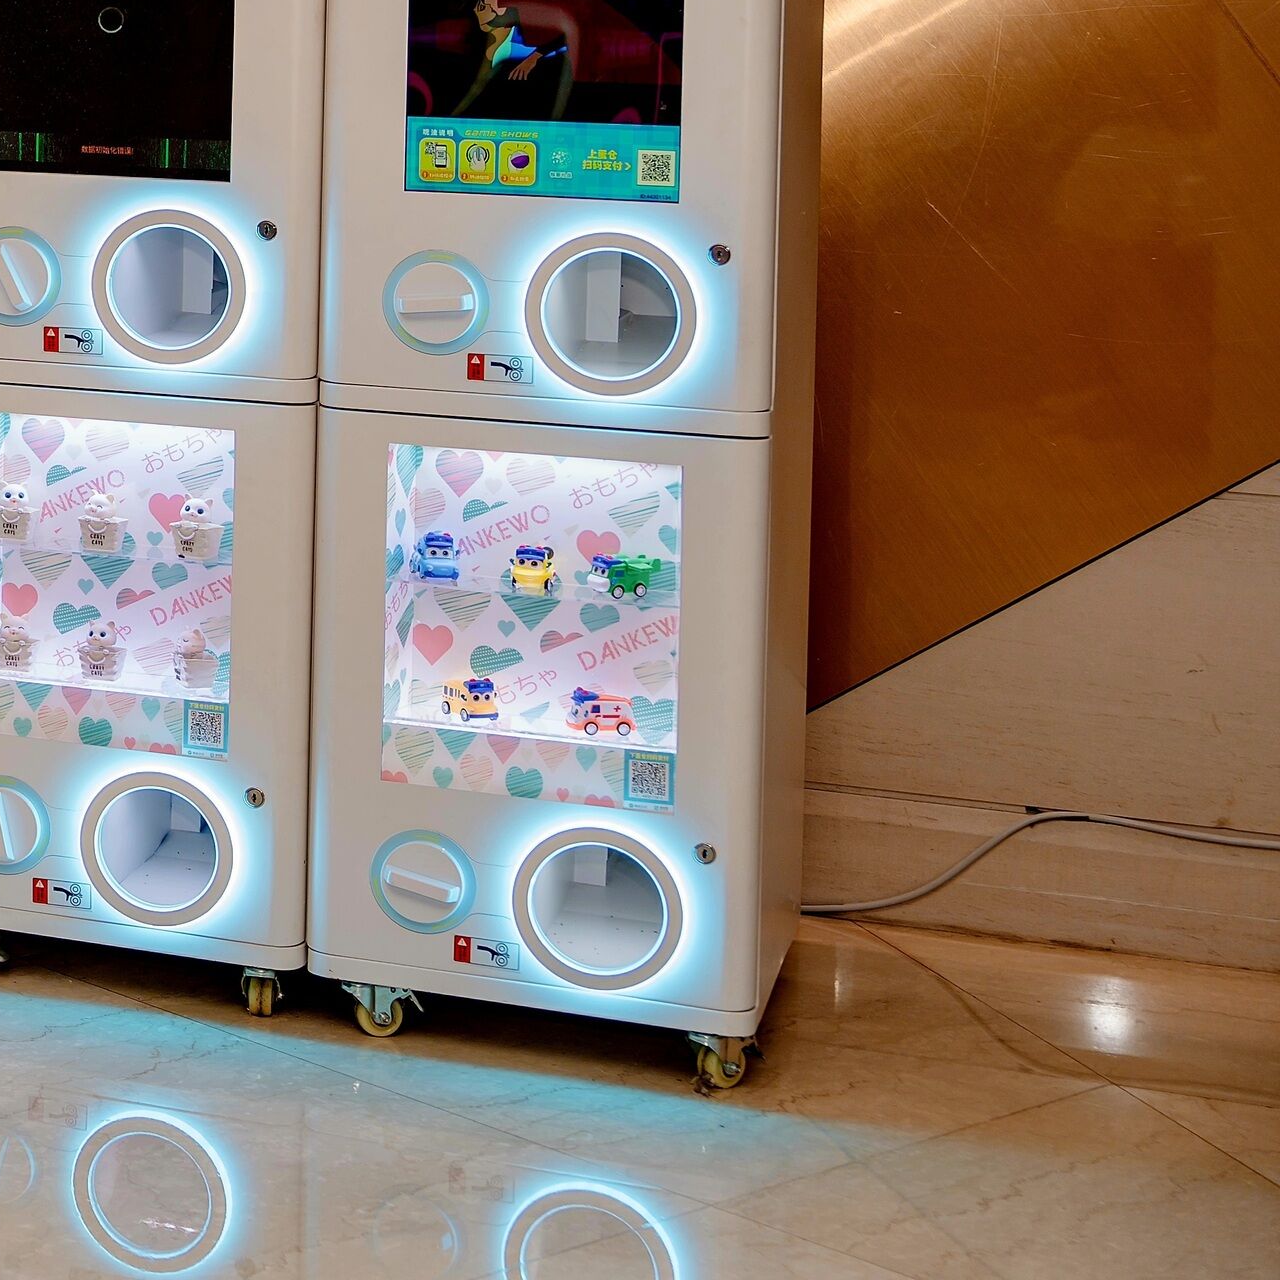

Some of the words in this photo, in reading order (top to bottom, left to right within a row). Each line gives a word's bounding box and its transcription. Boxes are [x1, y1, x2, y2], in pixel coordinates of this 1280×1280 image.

[582, 159, 623, 172] 扫码支付
[40, 469, 126, 523] ANKEWO
[455, 504, 551, 558] ANKEWO
